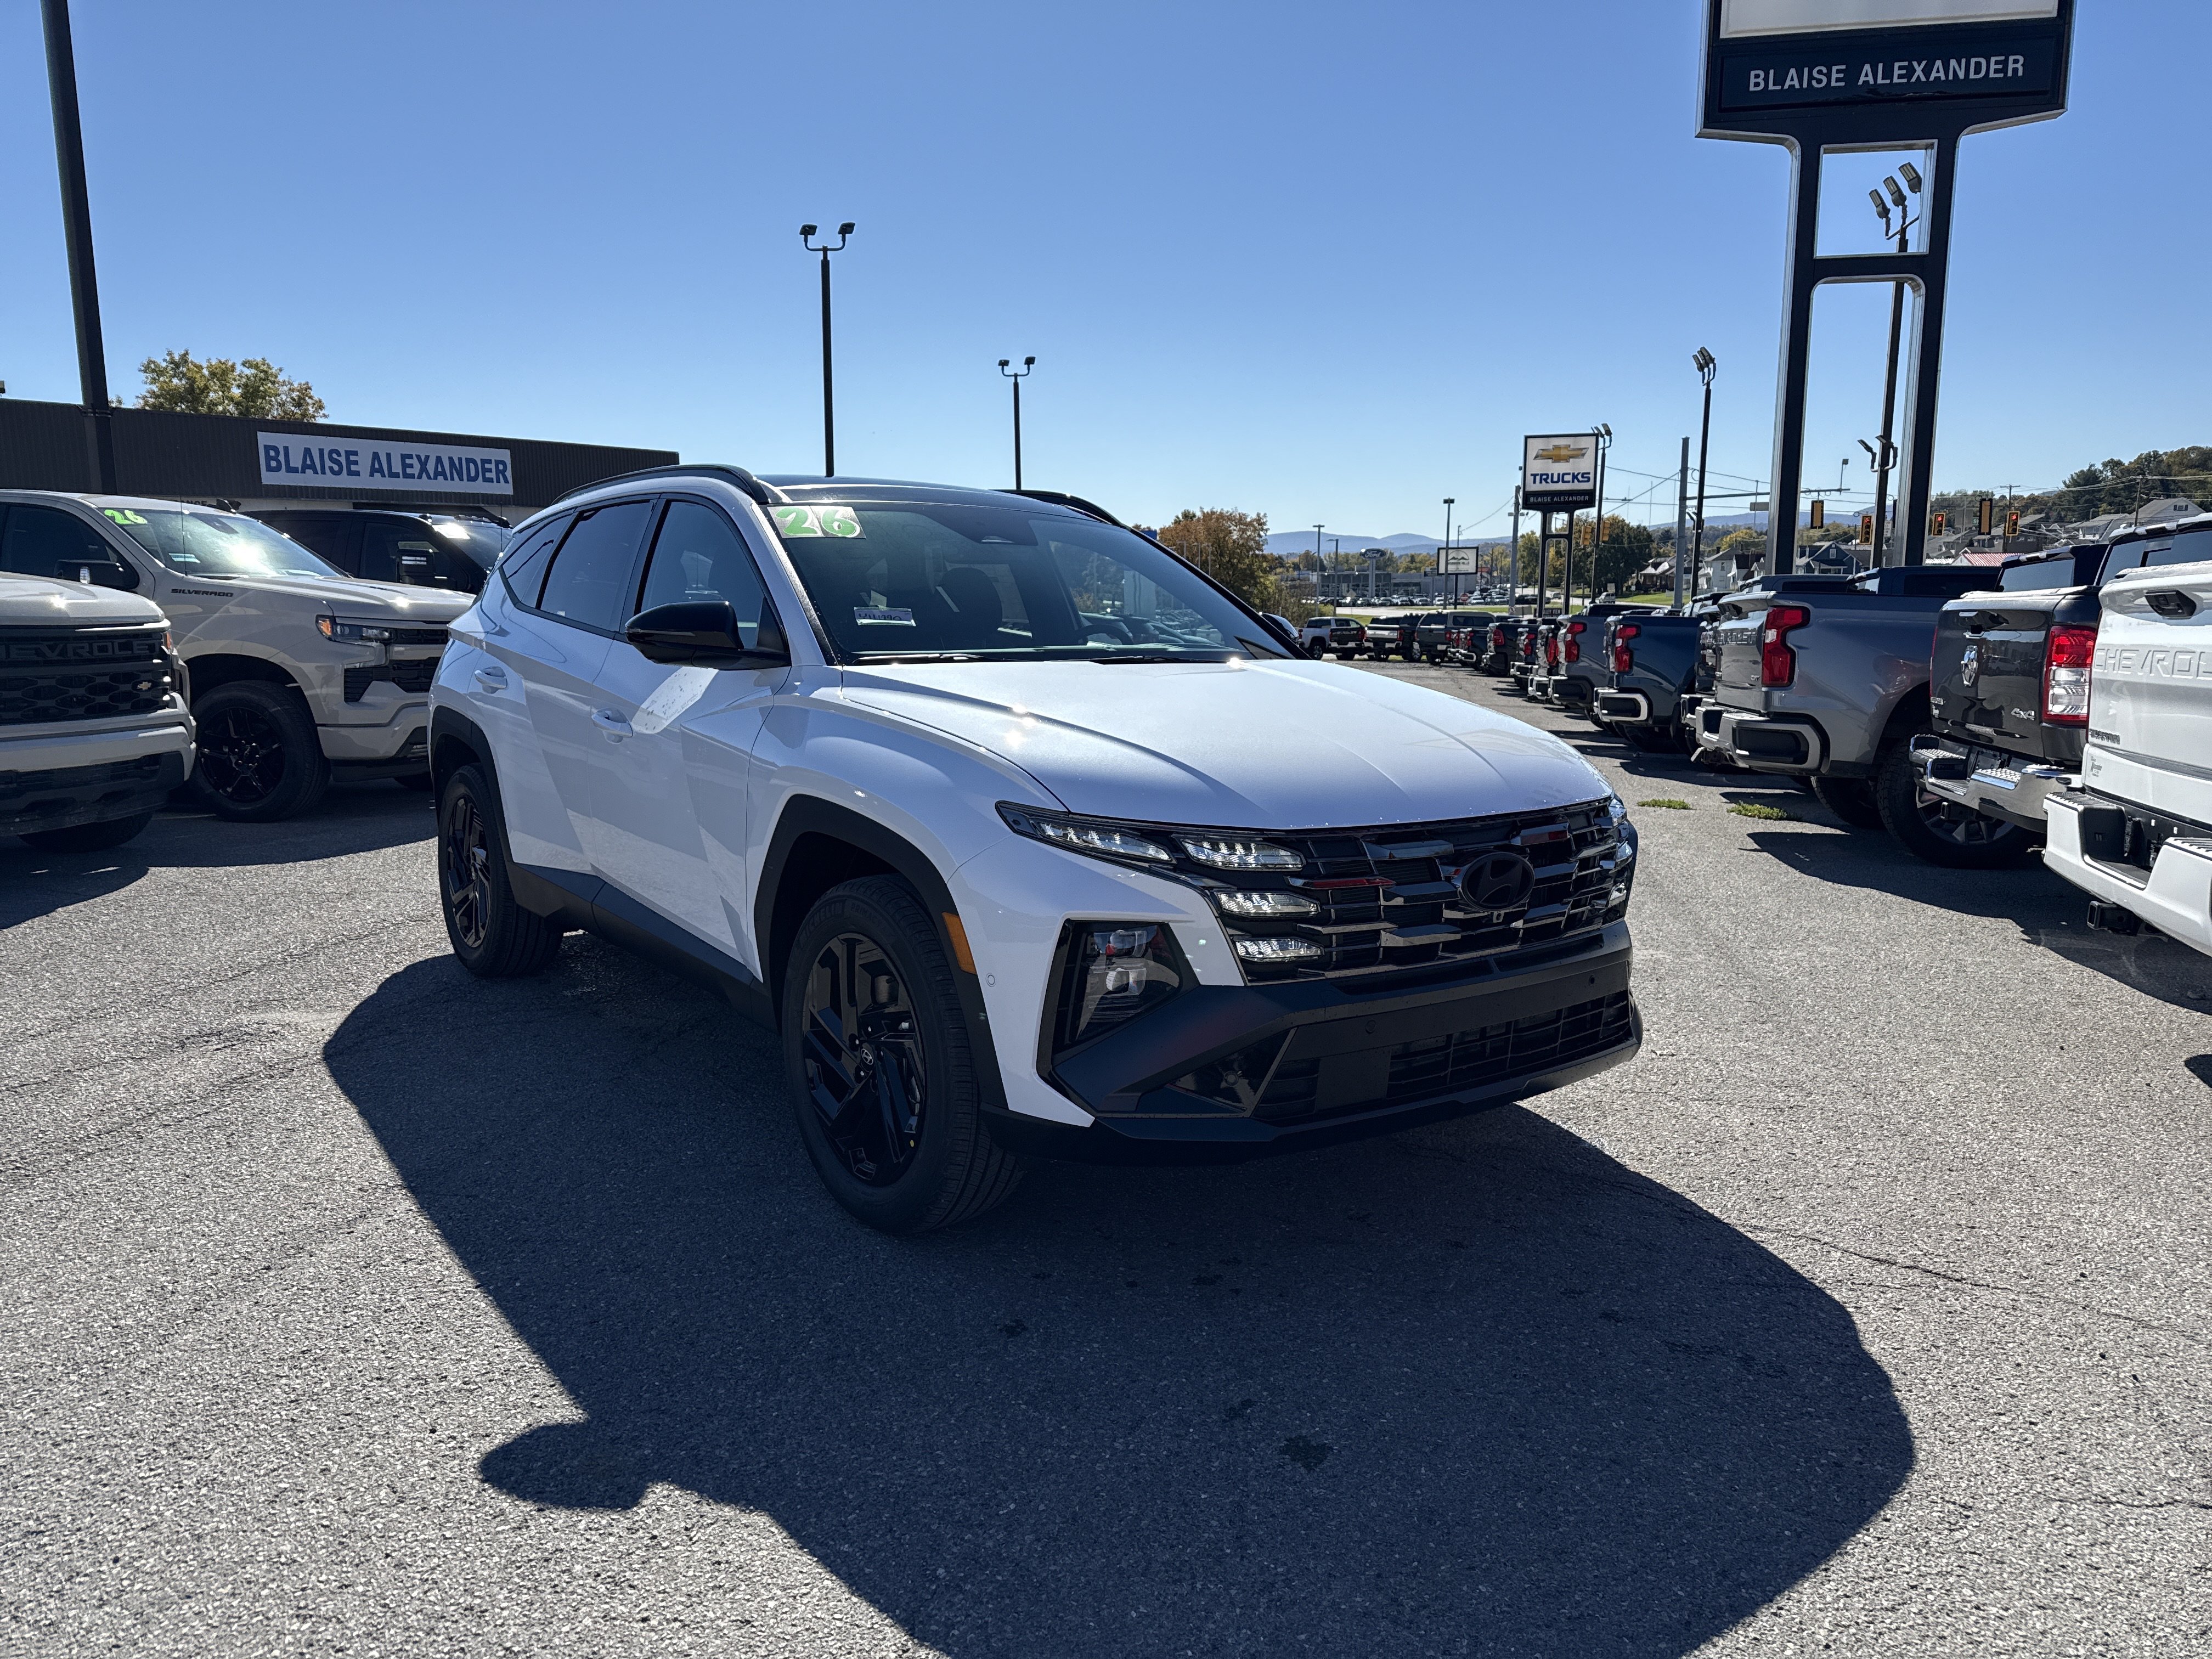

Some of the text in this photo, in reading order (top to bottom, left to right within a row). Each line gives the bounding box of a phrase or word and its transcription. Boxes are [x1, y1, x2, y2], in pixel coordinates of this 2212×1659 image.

[1749, 55, 2025, 92] BLAISE ALEXANDER
[263, 444, 510, 484] BLAISE ALEXANDER
[1530, 472, 1591, 484] TRUCKS
[104, 509, 147, 525] 26
[775, 507, 860, 538] 26
[171, 588, 234, 598] SILVERADO
[0, 640, 160, 659] EVROLET
[799, 901, 843, 949] MICHELIN
